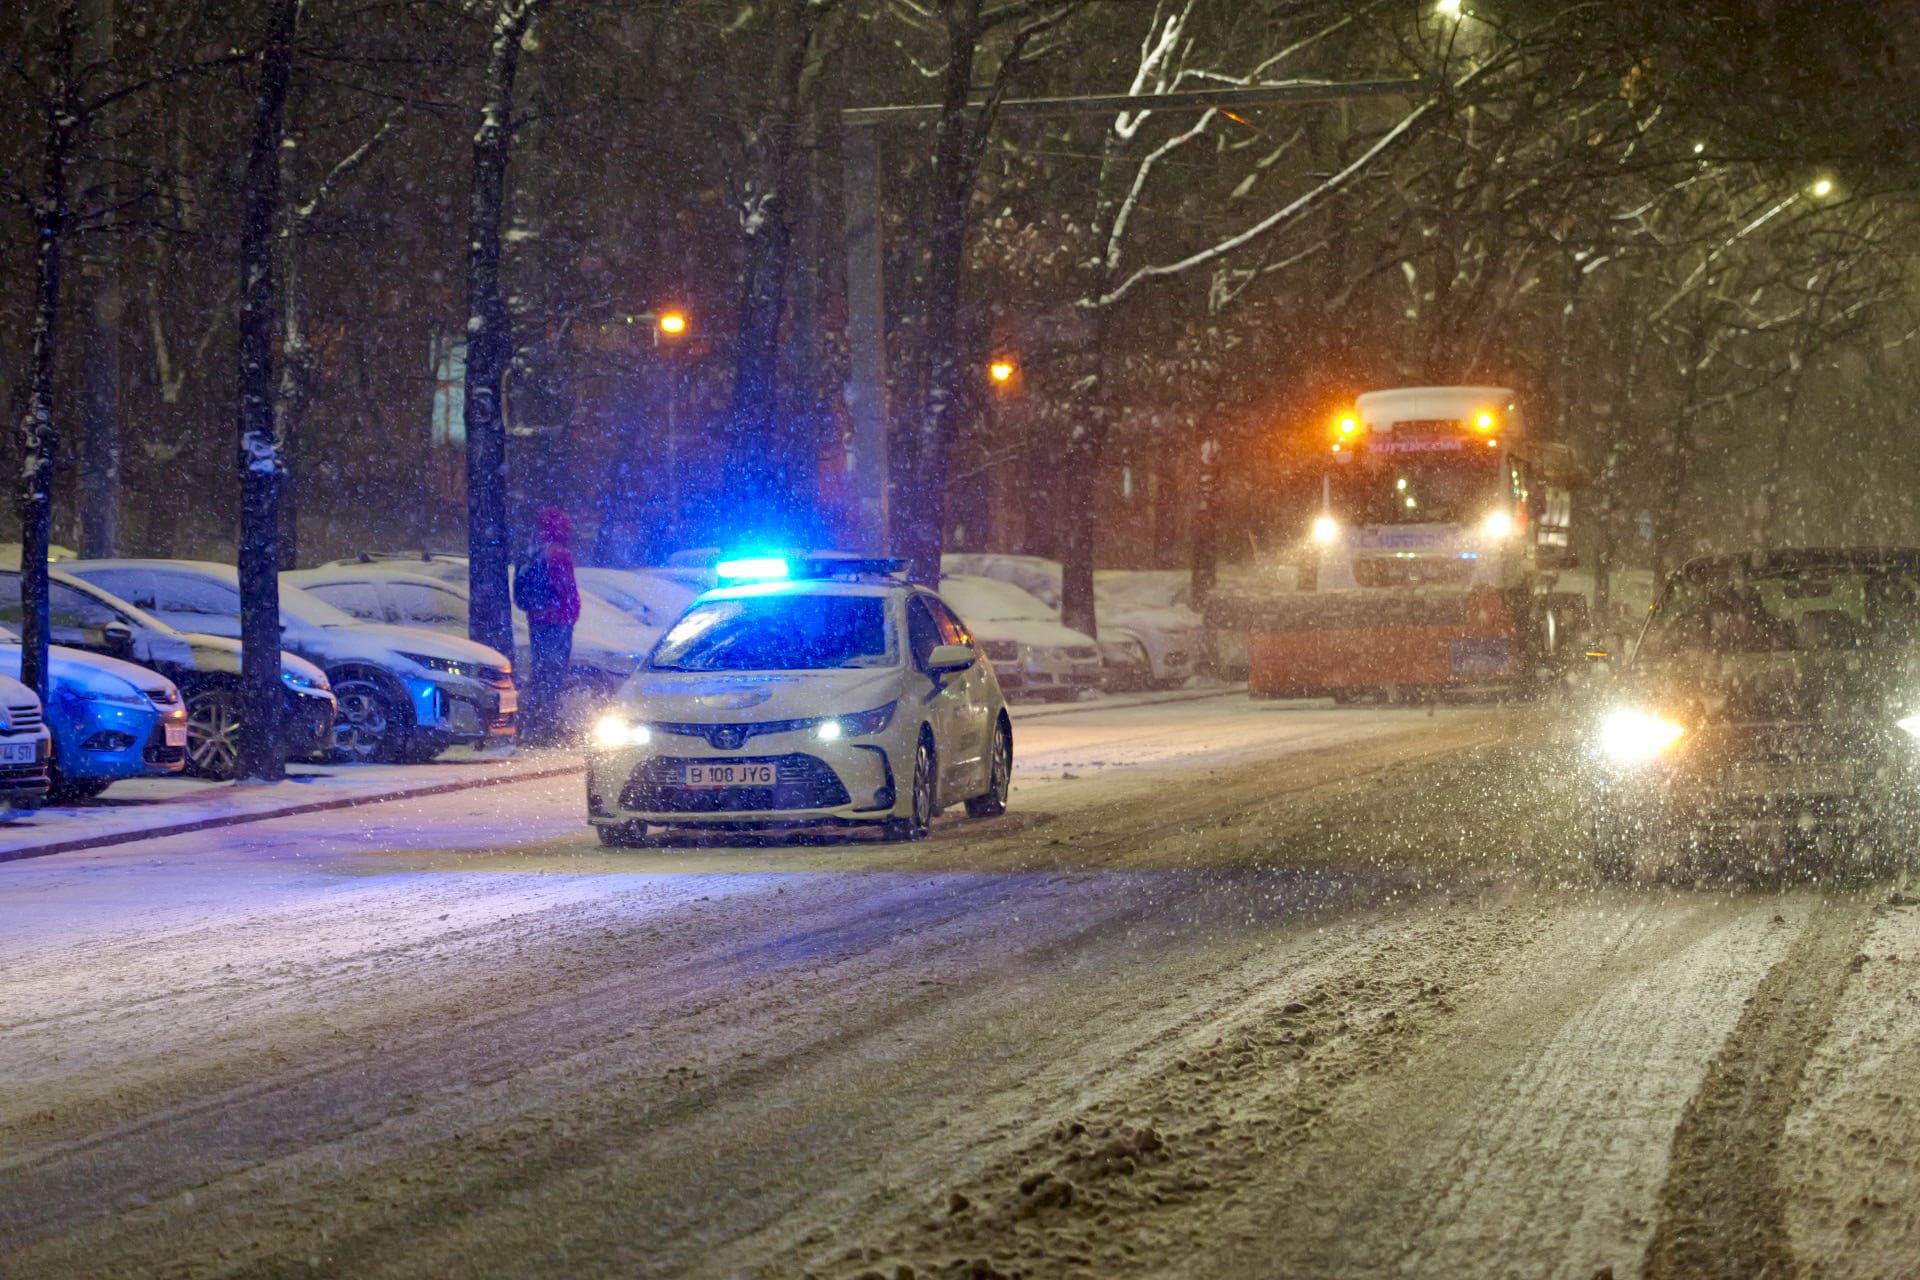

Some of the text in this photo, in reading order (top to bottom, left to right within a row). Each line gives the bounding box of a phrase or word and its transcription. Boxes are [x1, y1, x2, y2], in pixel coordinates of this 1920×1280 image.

[691, 766, 771, 783] B 108 JYG
